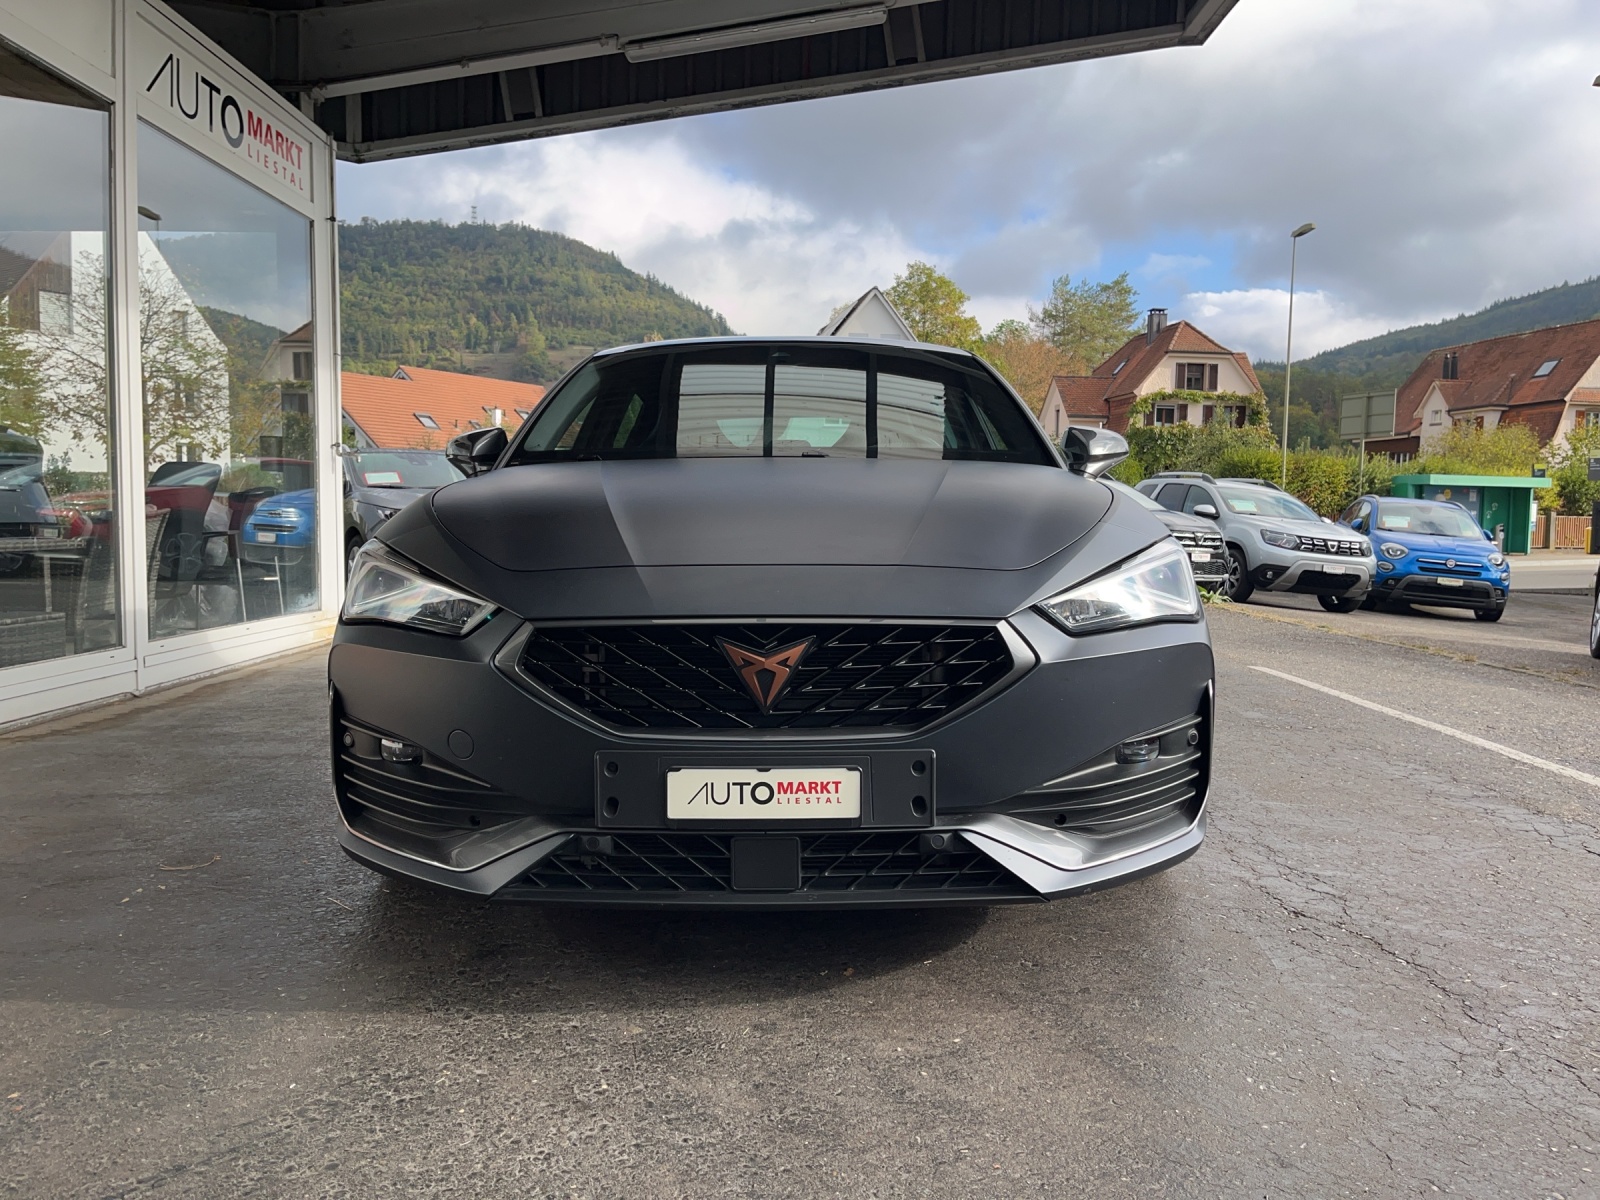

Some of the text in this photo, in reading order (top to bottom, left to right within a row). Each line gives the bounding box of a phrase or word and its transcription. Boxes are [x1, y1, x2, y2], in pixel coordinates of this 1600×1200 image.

[247, 109, 303, 170] MARKT
[247, 143, 304, 191] LIESTAL
[777, 781, 842, 795] MARKT
